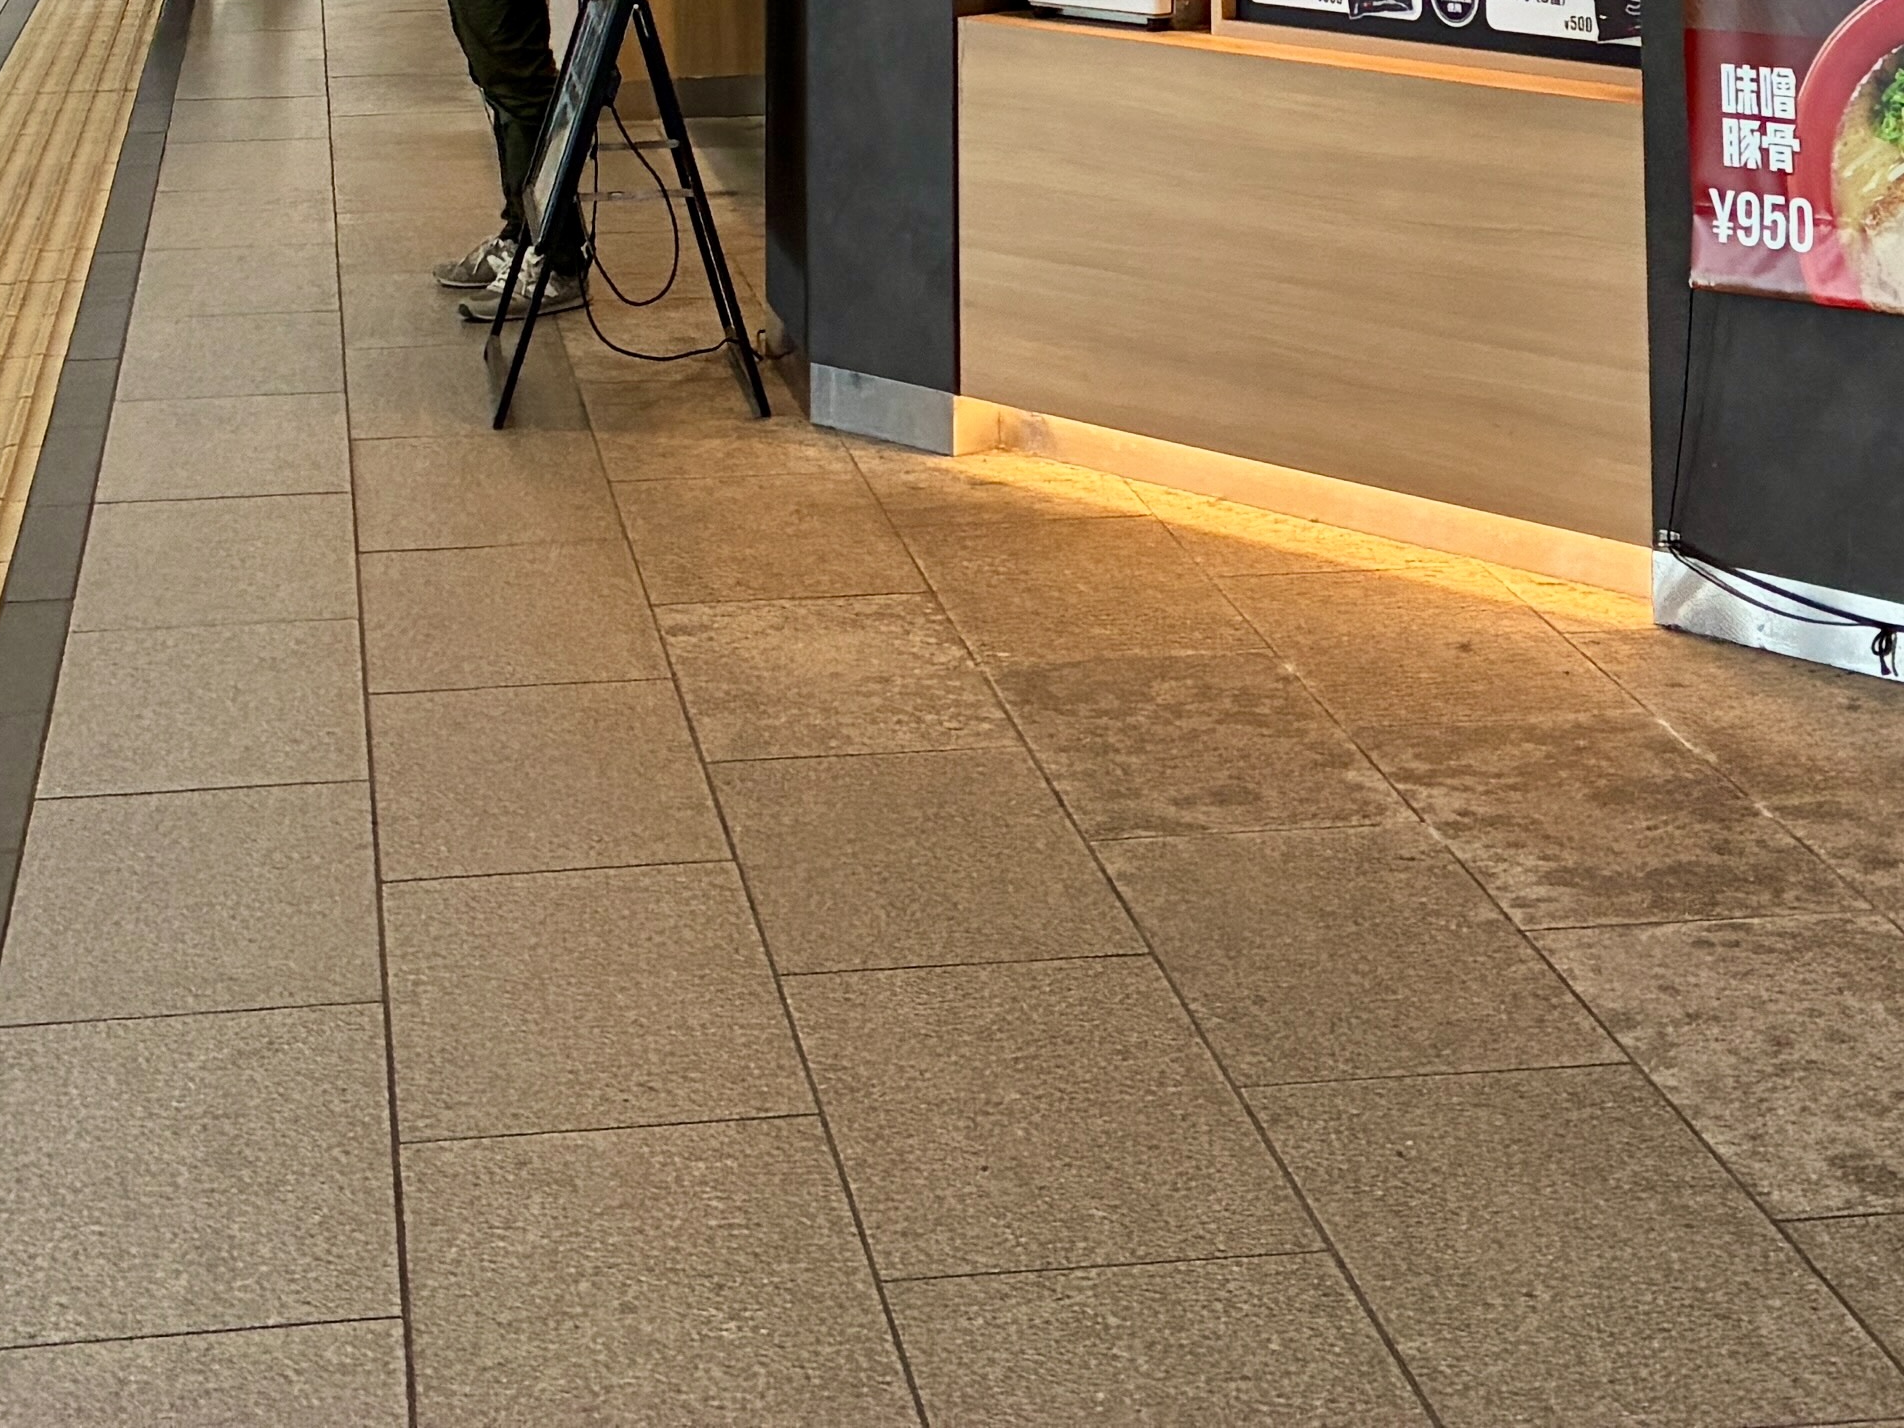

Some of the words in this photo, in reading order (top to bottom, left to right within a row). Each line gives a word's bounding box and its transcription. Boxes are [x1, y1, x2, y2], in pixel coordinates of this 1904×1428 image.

[1564, 15, 1593, 33] ¥500
[1720, 63, 1797, 120] 味噌
[1722, 119, 1801, 175] 豚骨
[1709, 187, 1814, 254] ¥950
